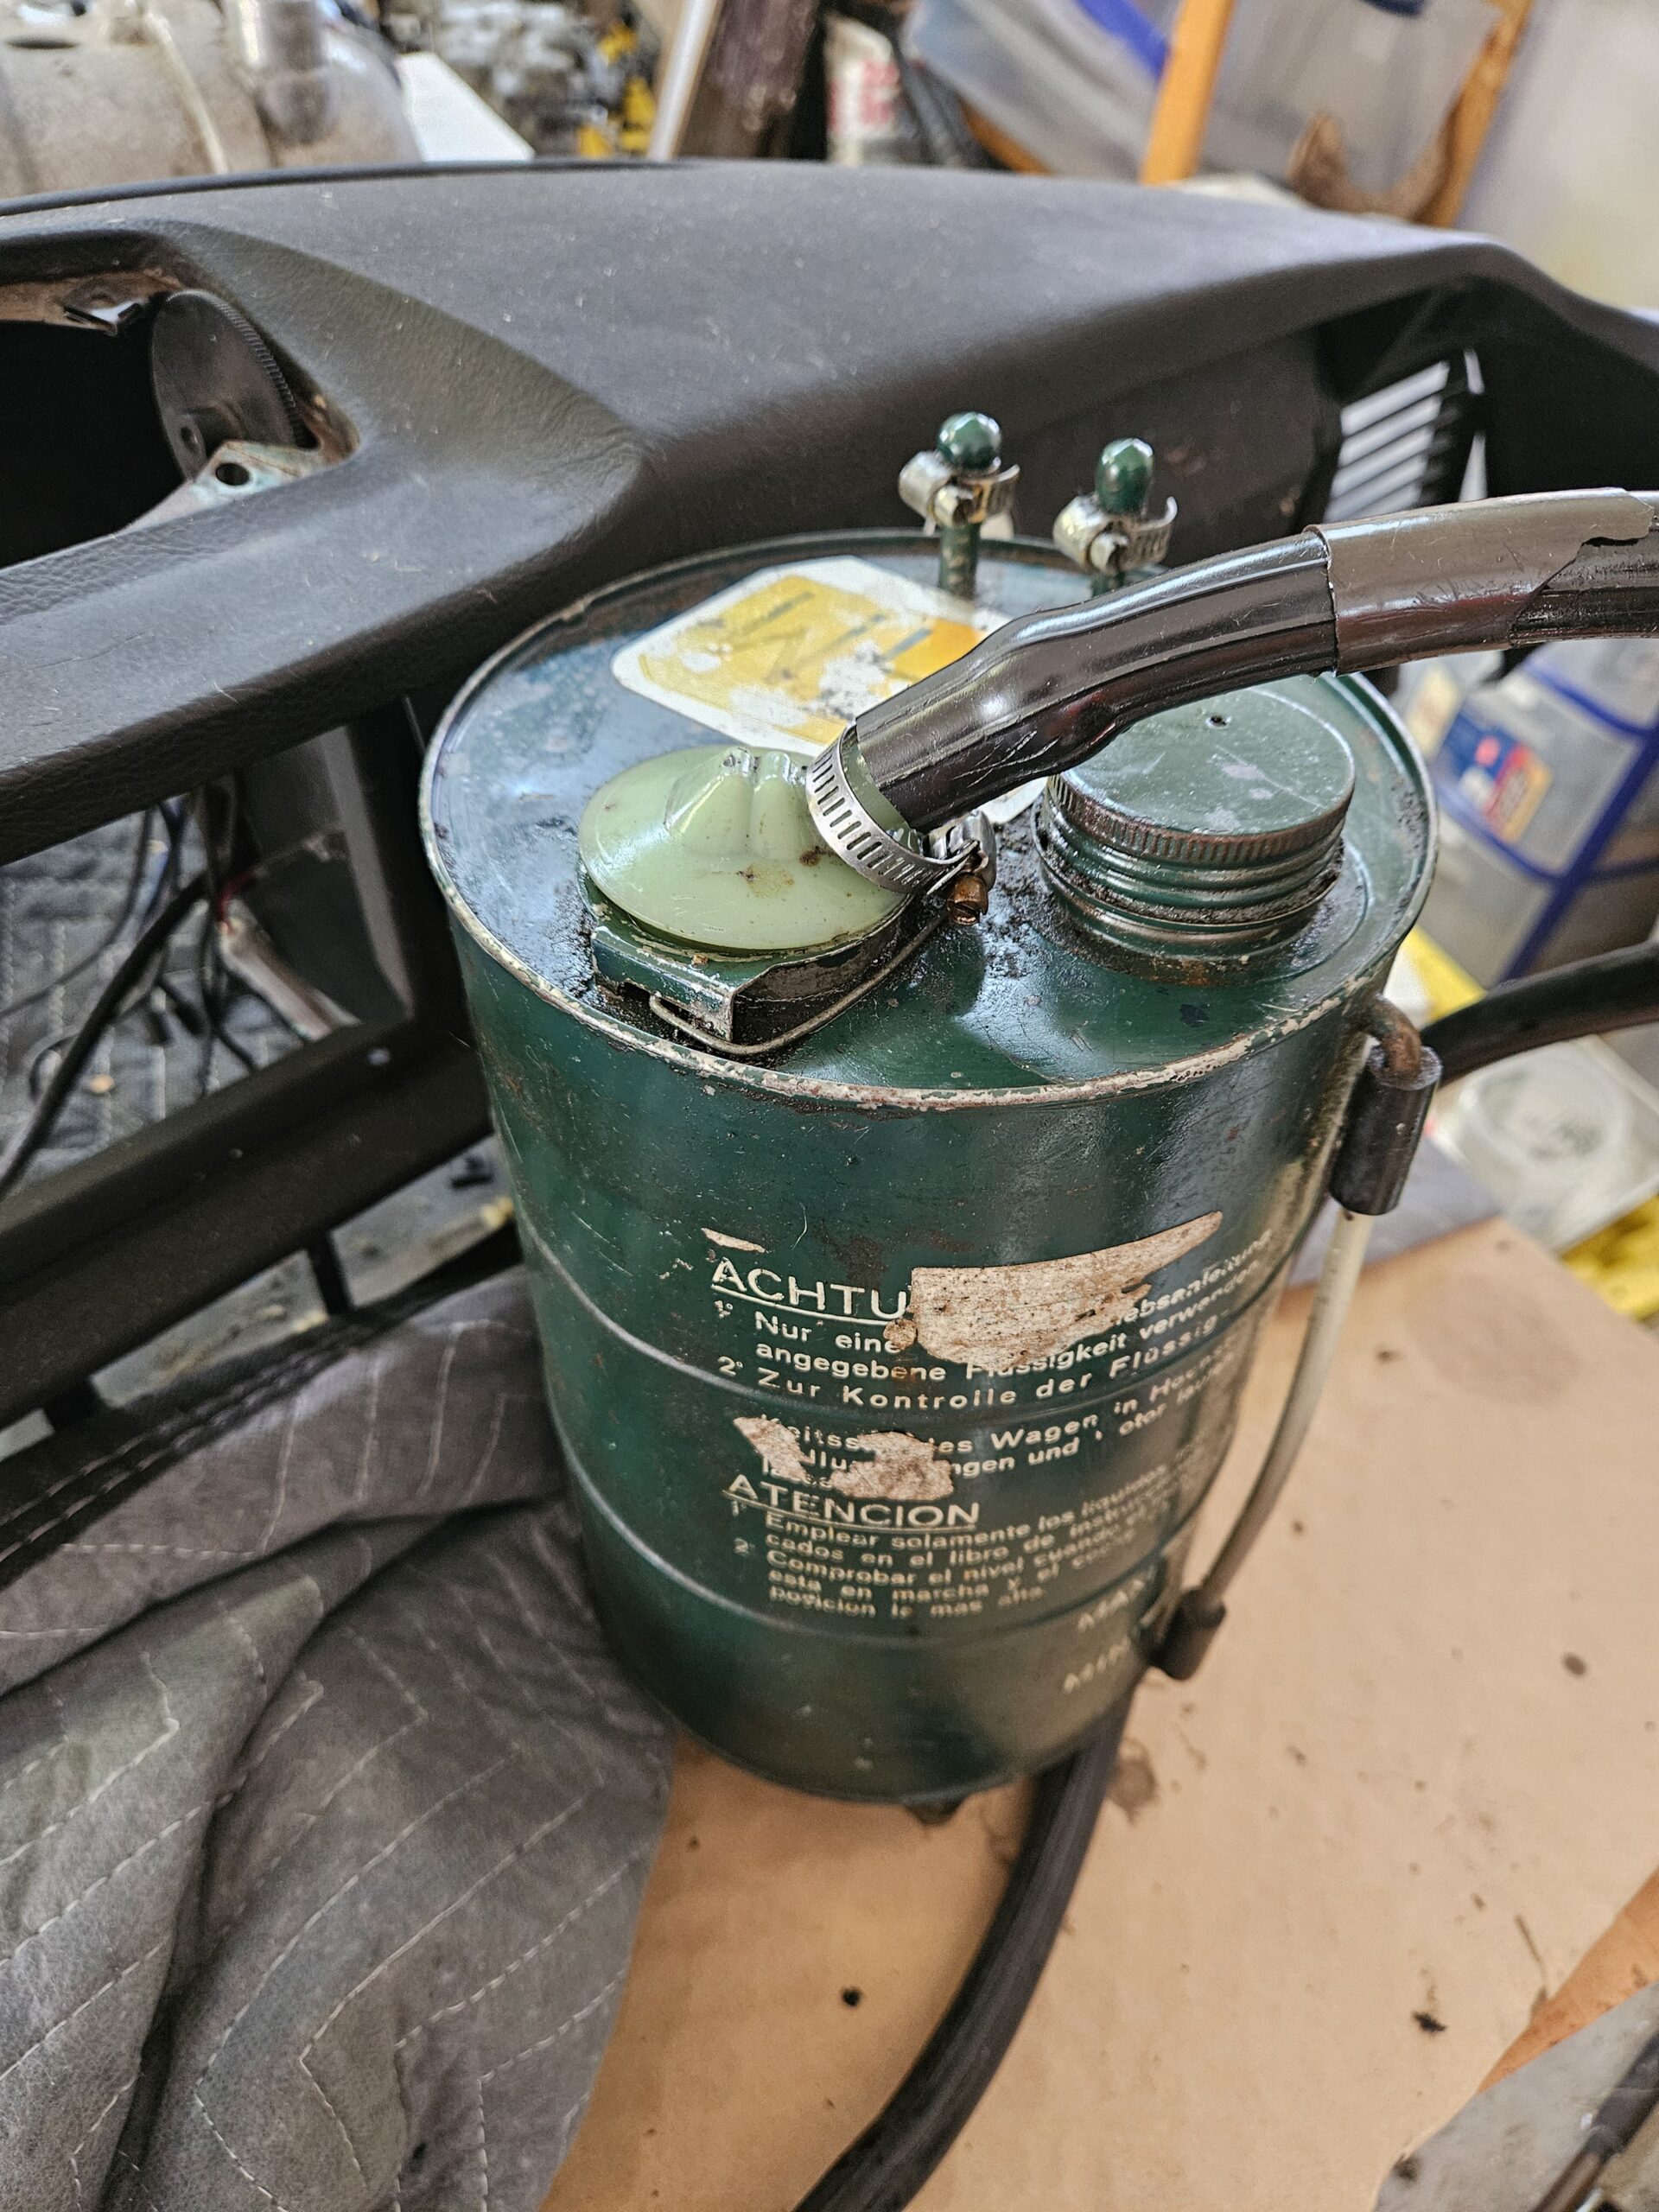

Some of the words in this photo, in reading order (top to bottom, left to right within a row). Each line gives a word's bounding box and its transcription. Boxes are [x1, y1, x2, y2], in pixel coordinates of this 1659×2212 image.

[711, 1256, 907, 1320] ACHTU
[754, 1310, 812, 1342] Nur
[755, 1342, 947, 1382] angegebene
[757, 1366, 821, 1398] Zur
[842, 1384, 1018, 1410] Kontrolle
[1036, 1372, 1093, 1400] der
[990, 1412, 1099, 1452] Wagen
[1113, 1397, 1139, 1415] in
[1027, 1436, 1082, 1467] und
[727, 1473, 980, 1529] ATENCION
[765, 1510, 880, 1549] Emplear
[765, 1534, 845, 1560] cados
[860, 1552, 893, 1568] en
[908, 1550, 934, 1569] el
[949, 1544, 1010, 1566] libro
[1022, 1533, 1056, 1554] de
[766, 1549, 918, 1586] Comprobar
[927, 1567, 952, 1586] el
[962, 1555, 1025, 1582] nivel
[840, 1584, 874, 1600] en
[891, 1582, 989, 1603] marcha
